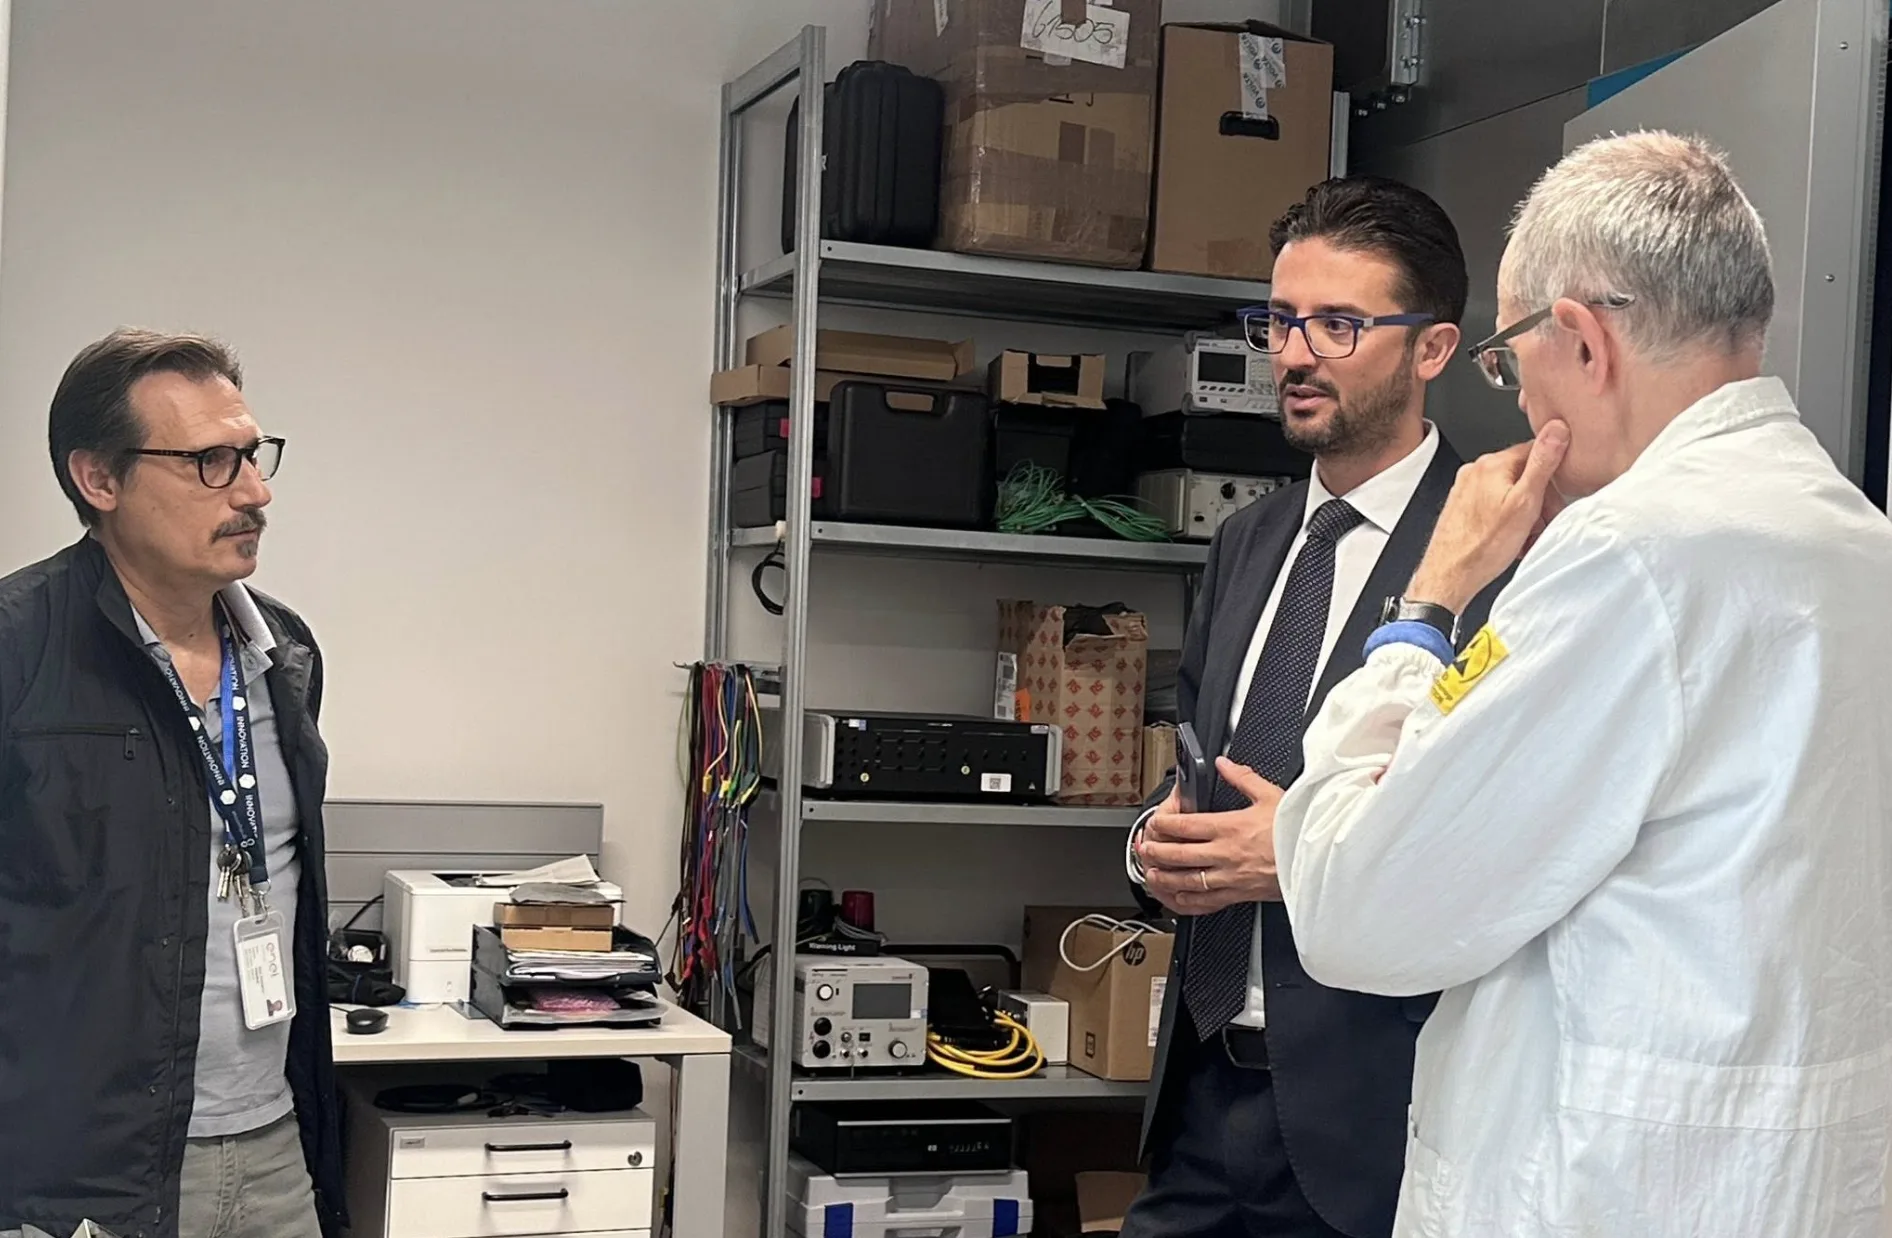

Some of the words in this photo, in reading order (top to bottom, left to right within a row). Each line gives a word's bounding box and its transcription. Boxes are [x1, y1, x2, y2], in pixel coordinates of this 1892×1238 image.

[165, 667, 190, 712] INNOVATIO
[197, 735, 225, 786] INNOVATION
[236, 716, 250, 769] INNOVATION
[1125, 941, 1145, 966] hp
